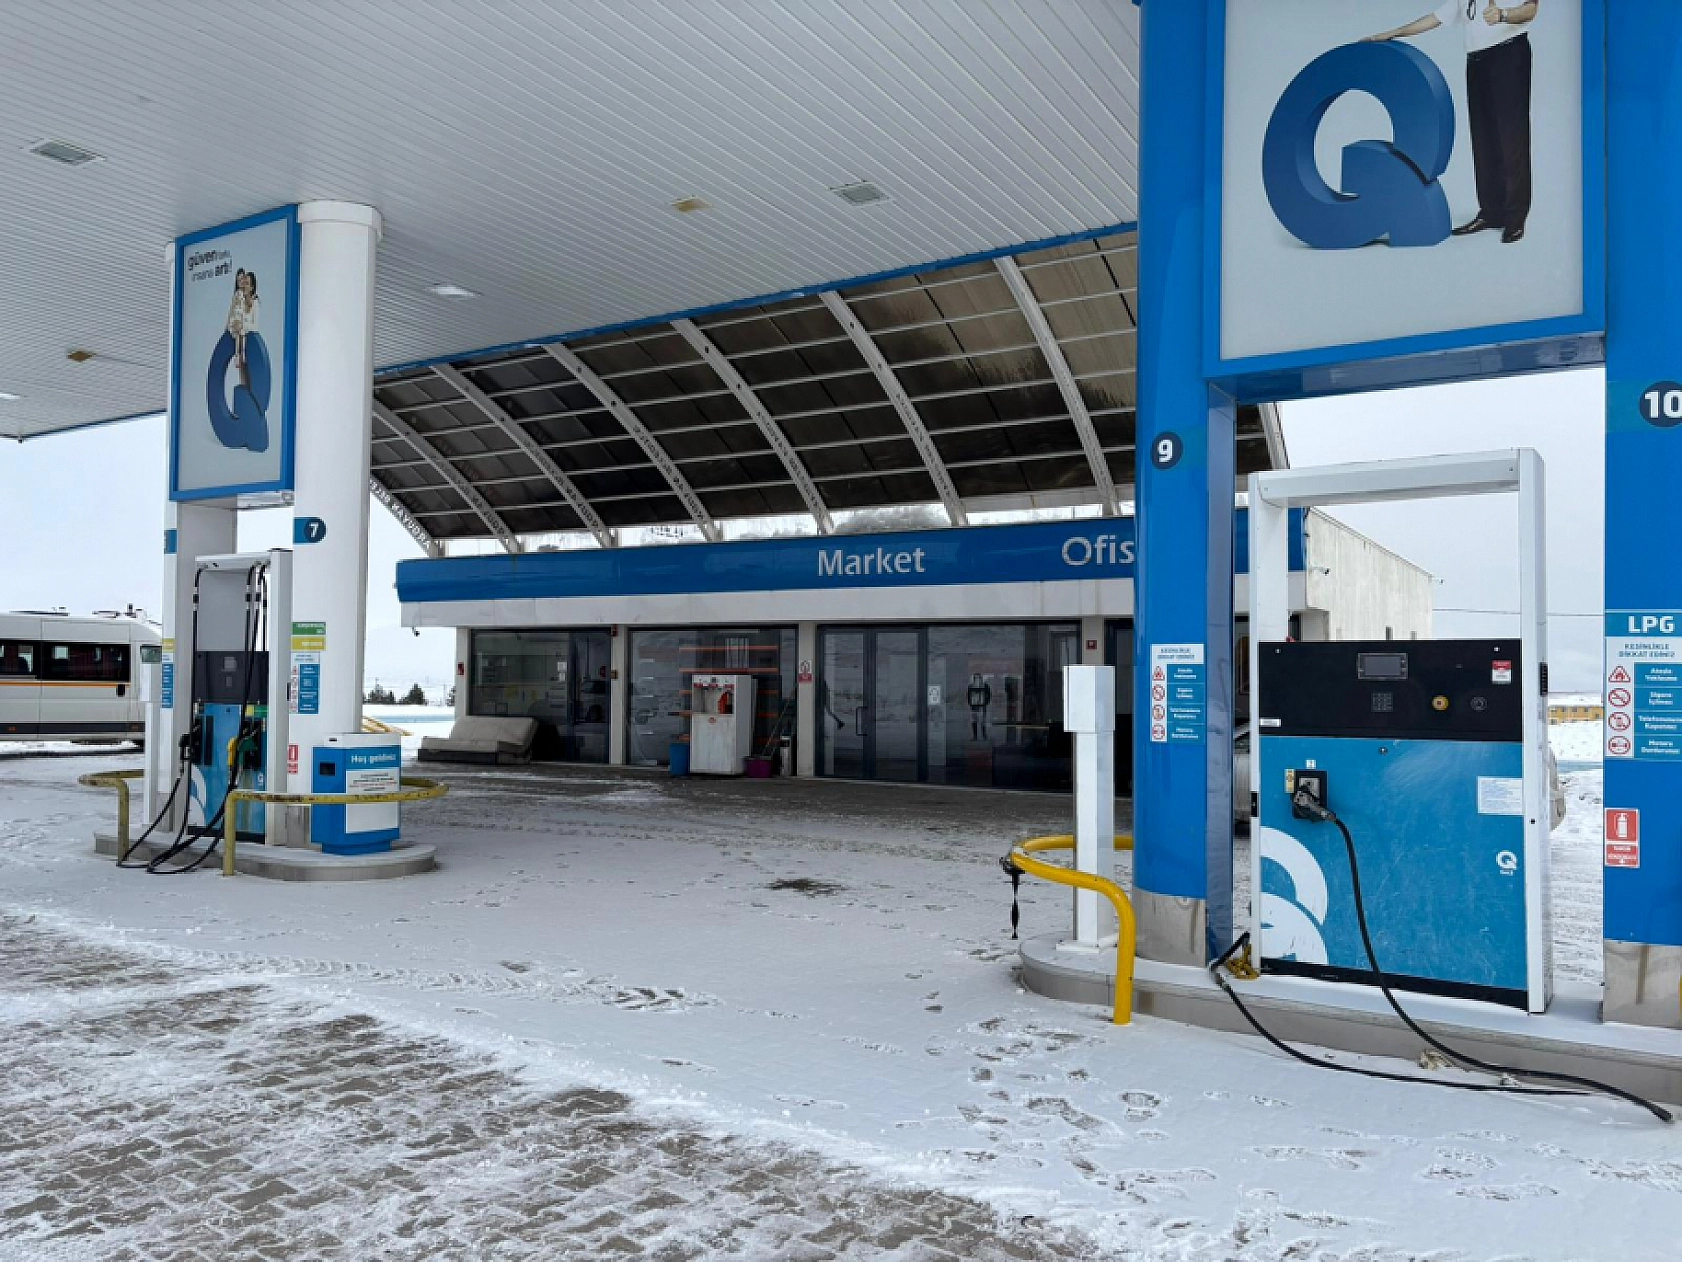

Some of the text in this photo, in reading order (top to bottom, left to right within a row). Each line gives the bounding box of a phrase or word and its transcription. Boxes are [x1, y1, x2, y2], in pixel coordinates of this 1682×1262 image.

[1645, 389, 1682, 419] 10
[1157, 439, 1173, 463] 9
[309, 522, 319, 538] 7
[818, 547, 926, 577] Market
[1061, 534, 1135, 566] Ofis
[1628, 615, 1676, 633] LPG
